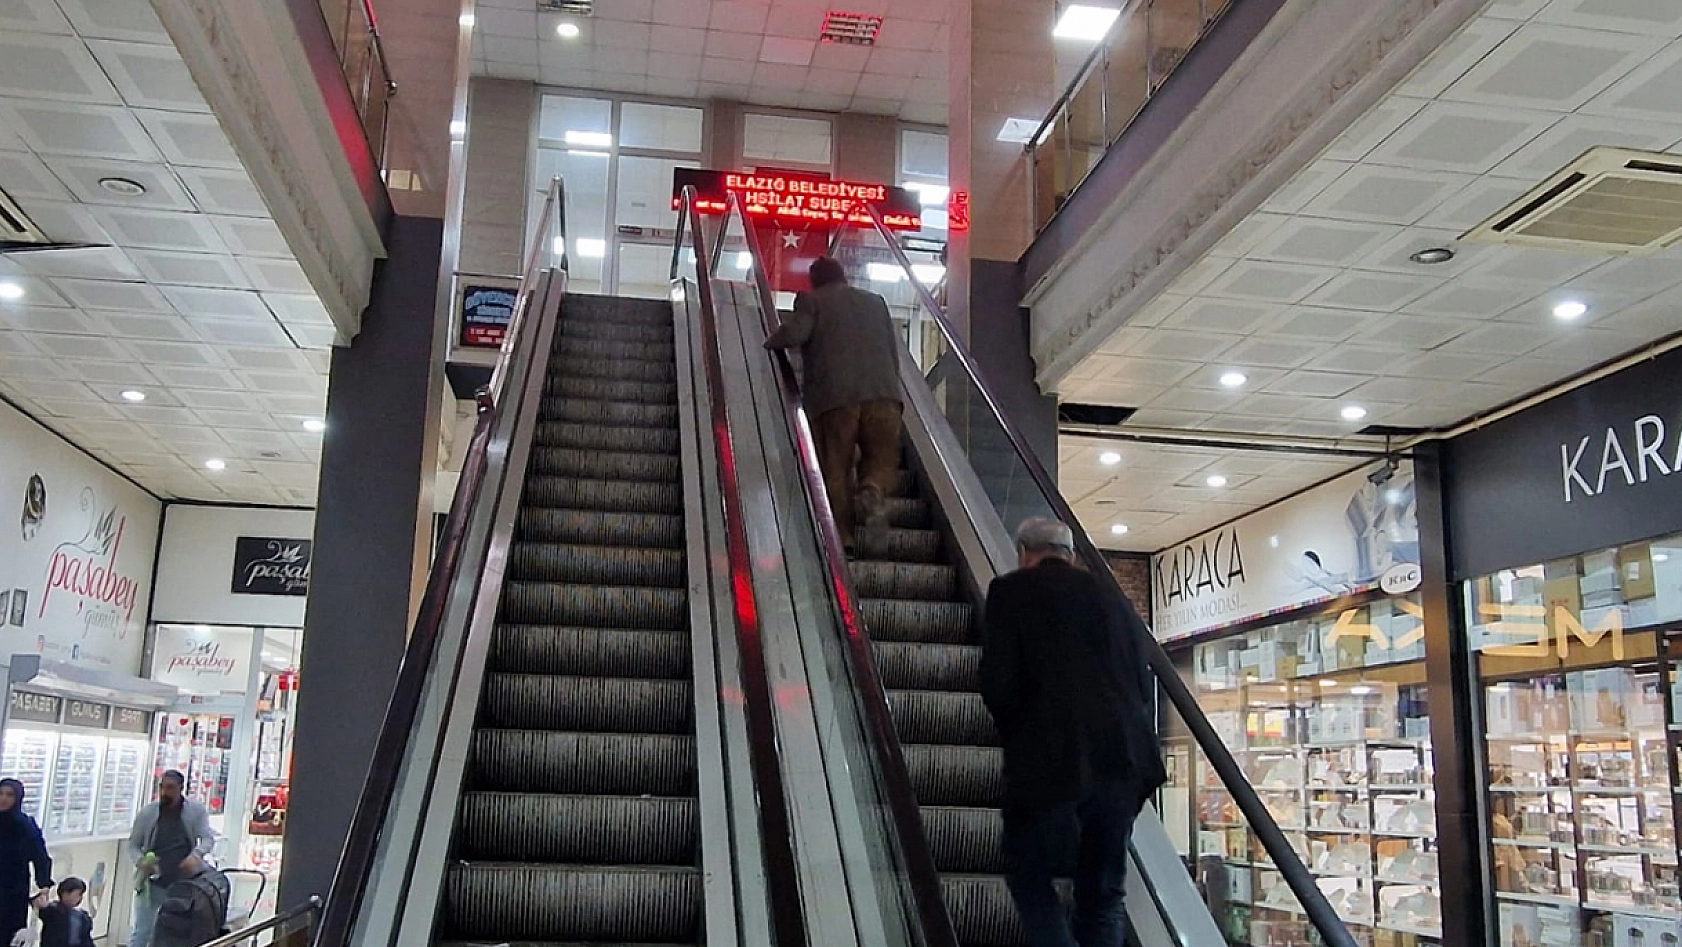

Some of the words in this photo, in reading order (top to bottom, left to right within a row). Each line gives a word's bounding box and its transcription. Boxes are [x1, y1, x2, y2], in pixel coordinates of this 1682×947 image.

[1560, 413, 1682, 502] KAR
[38, 515, 139, 639] paşabey
[1156, 525, 1246, 611] KARACA
